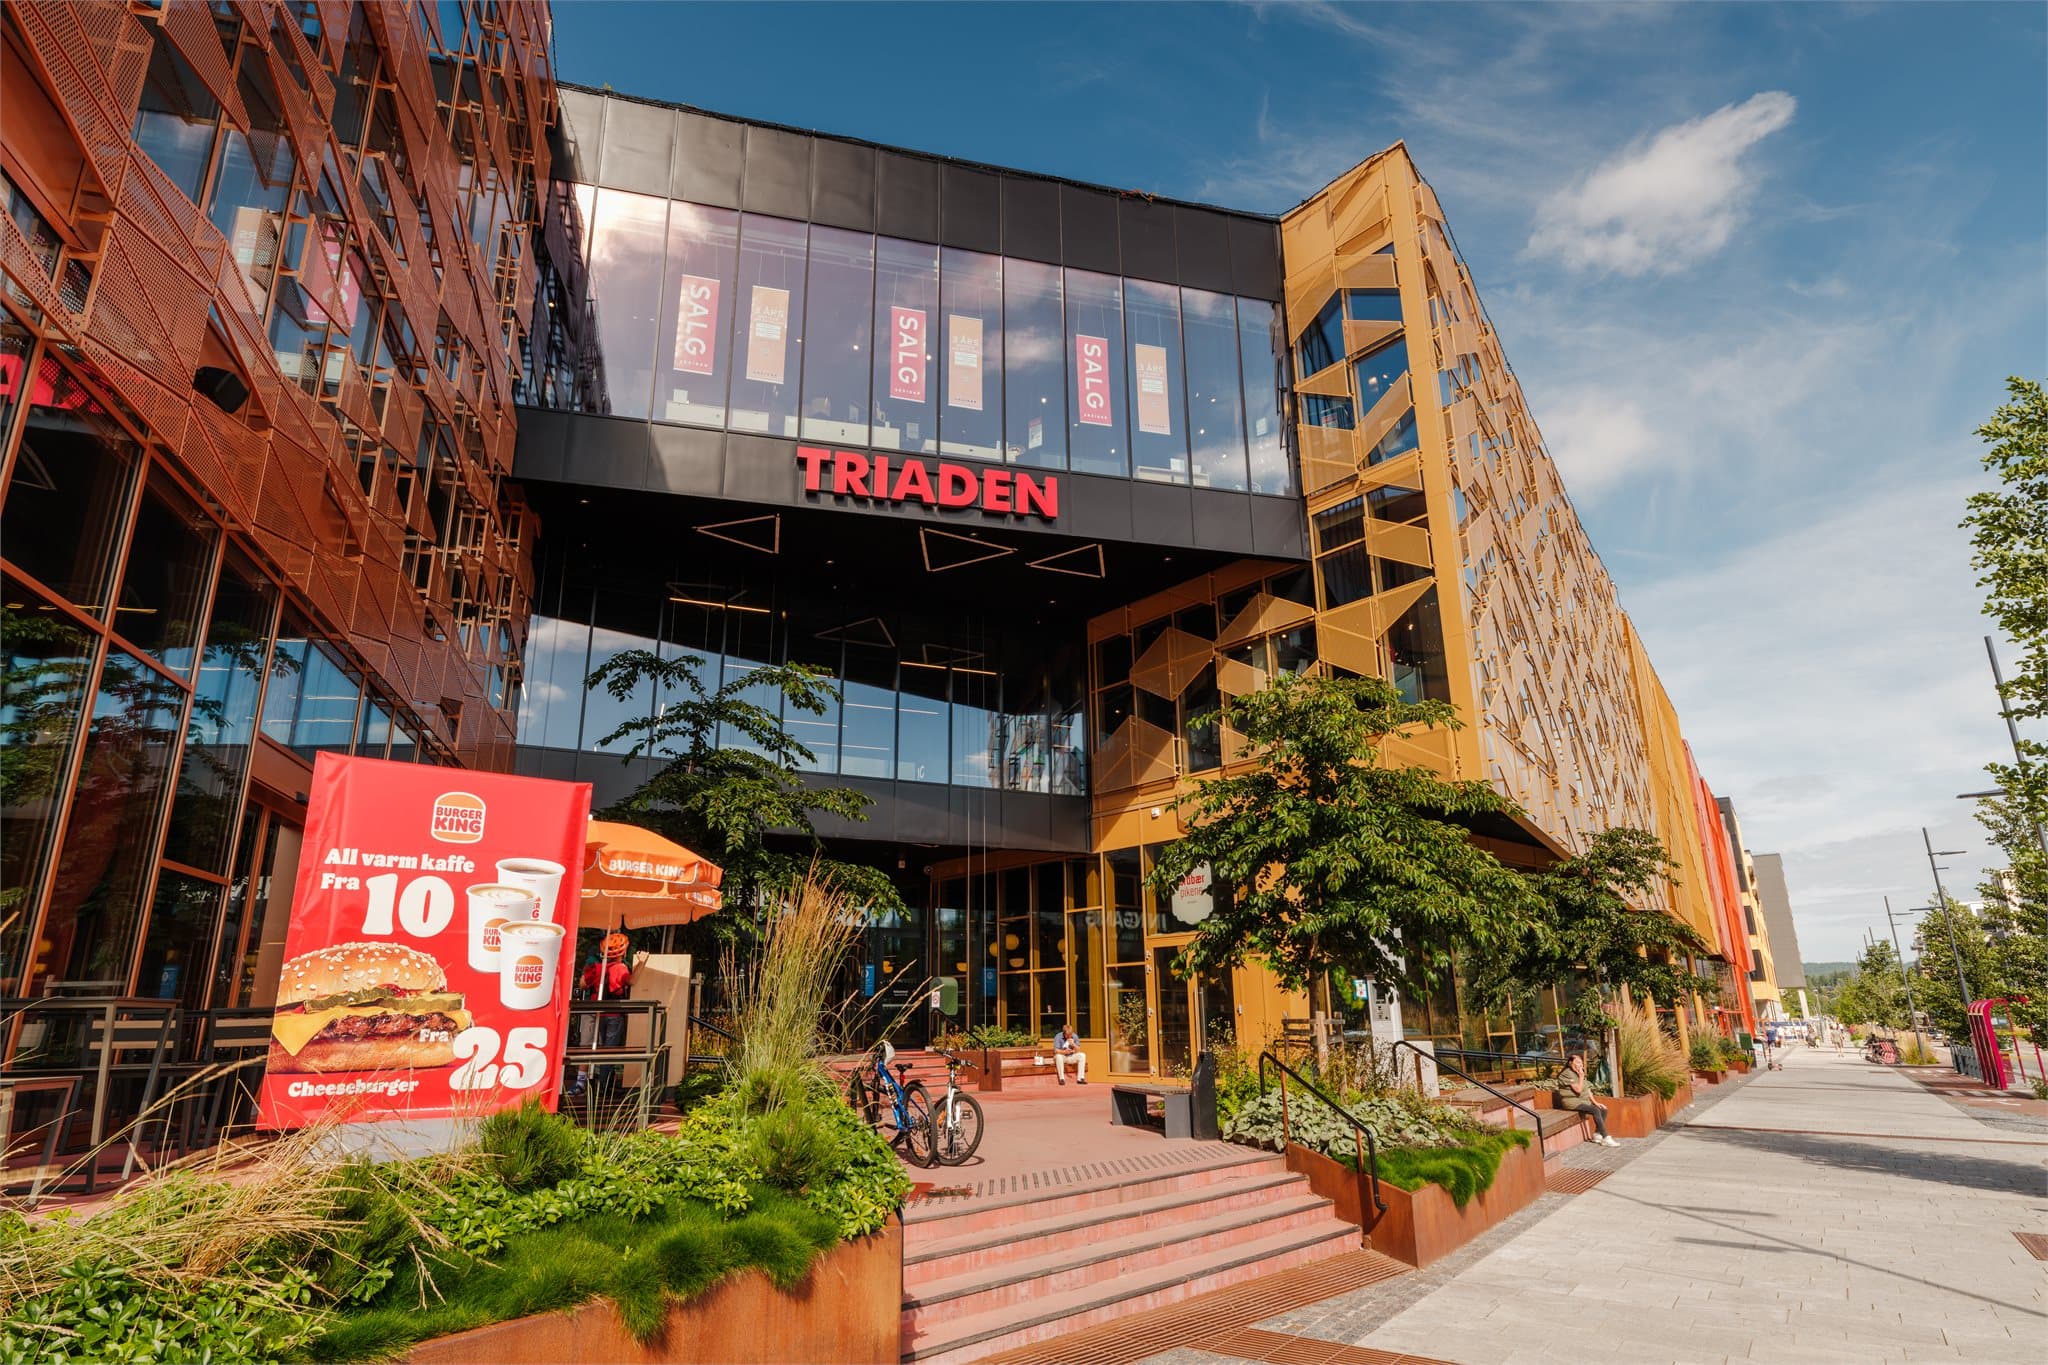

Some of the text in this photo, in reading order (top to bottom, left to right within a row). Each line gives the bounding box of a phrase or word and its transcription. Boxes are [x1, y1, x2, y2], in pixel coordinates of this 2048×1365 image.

[684, 284, 711, 356] SALG
[898, 315, 918, 385] SALG
[1084, 343, 1104, 409] SALG
[797, 446, 1059, 519] TRIADEN
[434, 817, 481, 833] KING
[436, 806, 482, 820] BURGER
[324, 848, 475, 873] All varm kaffe
[608, 859, 685, 877] BURGER KING
[320, 873, 455, 938] Fra 10
[514, 973, 542, 983] KING
[515, 965, 543, 973] BURGER
[420, 1026, 548, 1090] Fra 25
[287, 1079, 420, 1097] Cheeseburger
